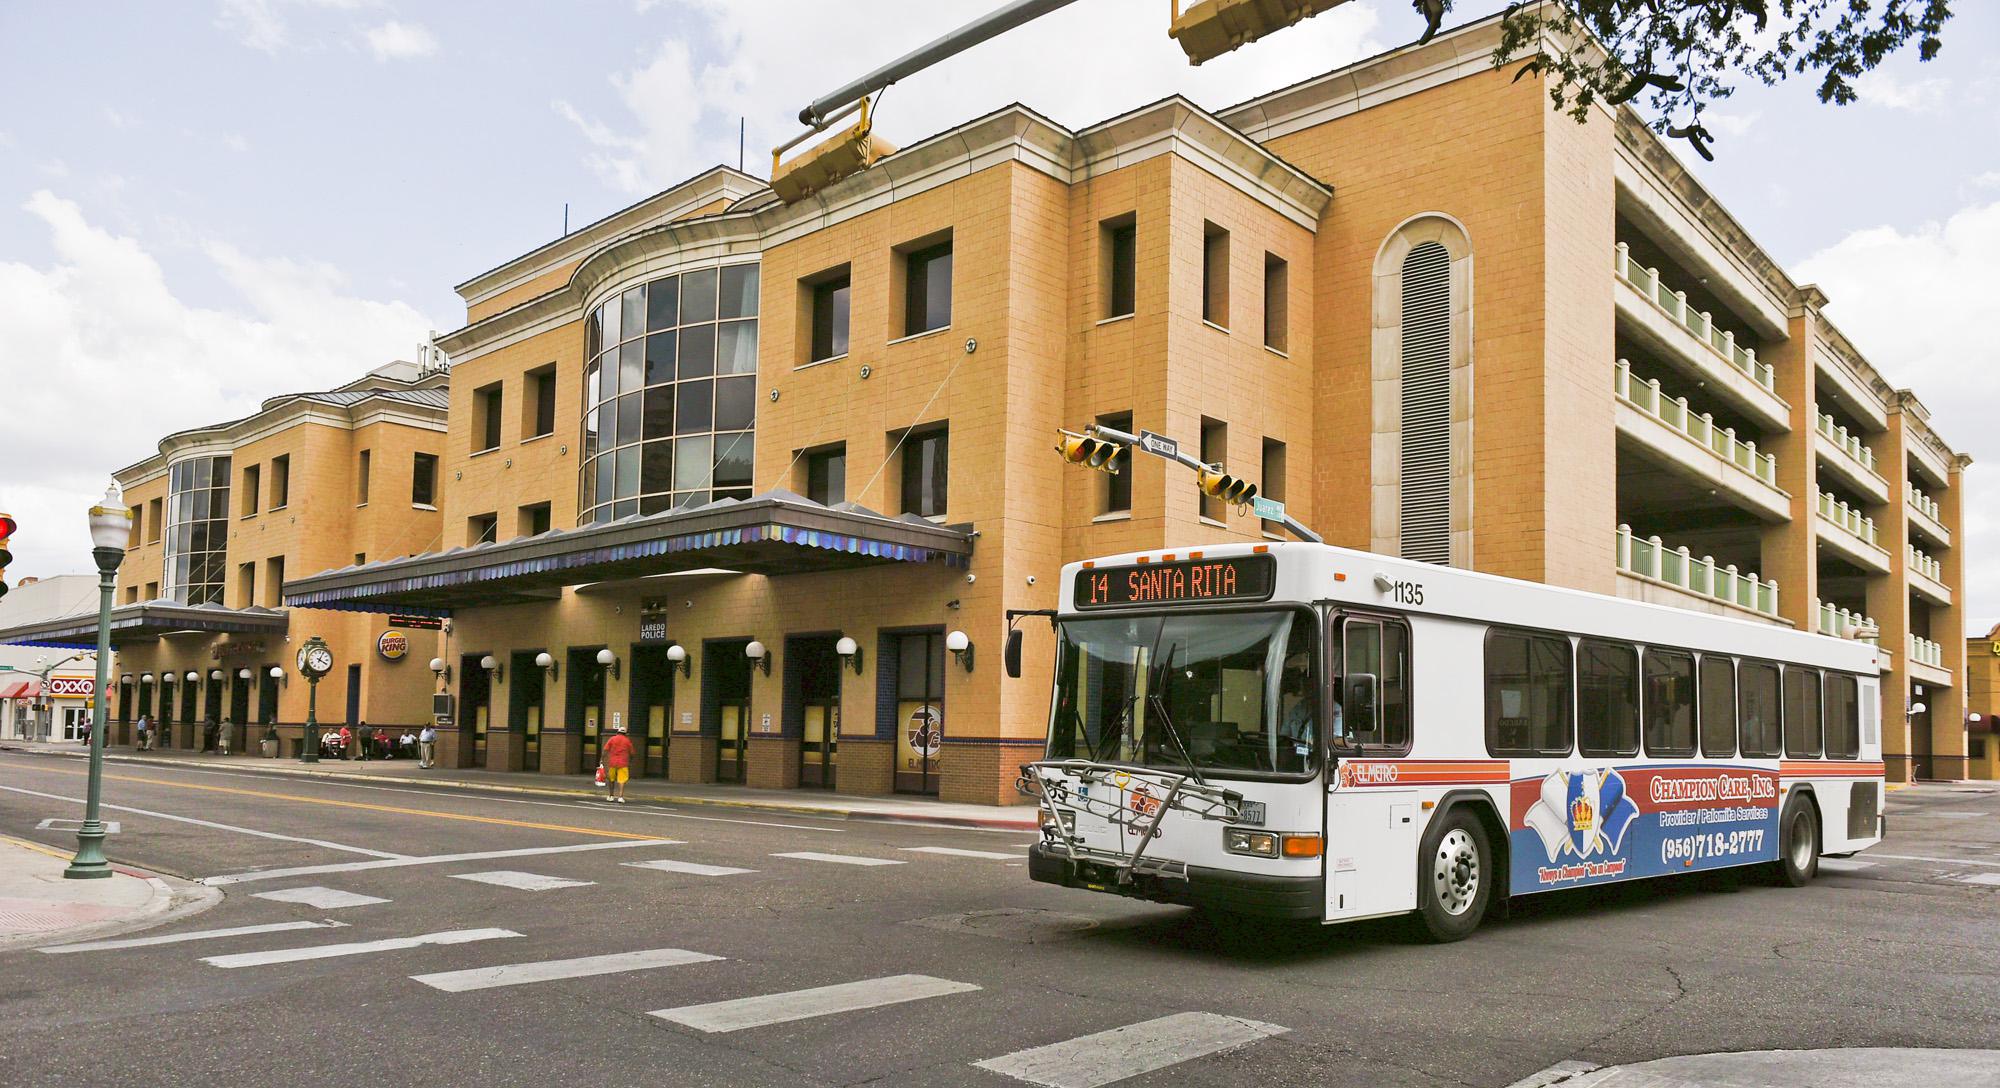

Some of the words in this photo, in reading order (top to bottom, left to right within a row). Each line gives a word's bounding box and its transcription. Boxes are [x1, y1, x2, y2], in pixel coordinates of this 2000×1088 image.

[1151, 439, 1162, 449] ONE
[1162, 443, 1174, 454] WAY
[1091, 573, 1108, 603] 14
[1128, 568, 1185, 601] SANTA
[1191, 564, 1236, 597] RITA
[1395, 580, 1424, 606] 1135
[641, 623, 666, 631] LAREDO
[382, 637, 406, 645] BURGER
[641, 631, 665, 639] POLICE
[382, 643, 406, 652] KING
[52, 679, 94, 694] OXXO
[1357, 764, 1367, 782] EL
[1368, 764, 1398, 782] METRO
[1651, 776, 1717, 802] CHAMPION
[1660, 810, 1696, 827] Provider
[1701, 808, 1736, 824] Palomita
[1737, 806, 1768, 821] Services
